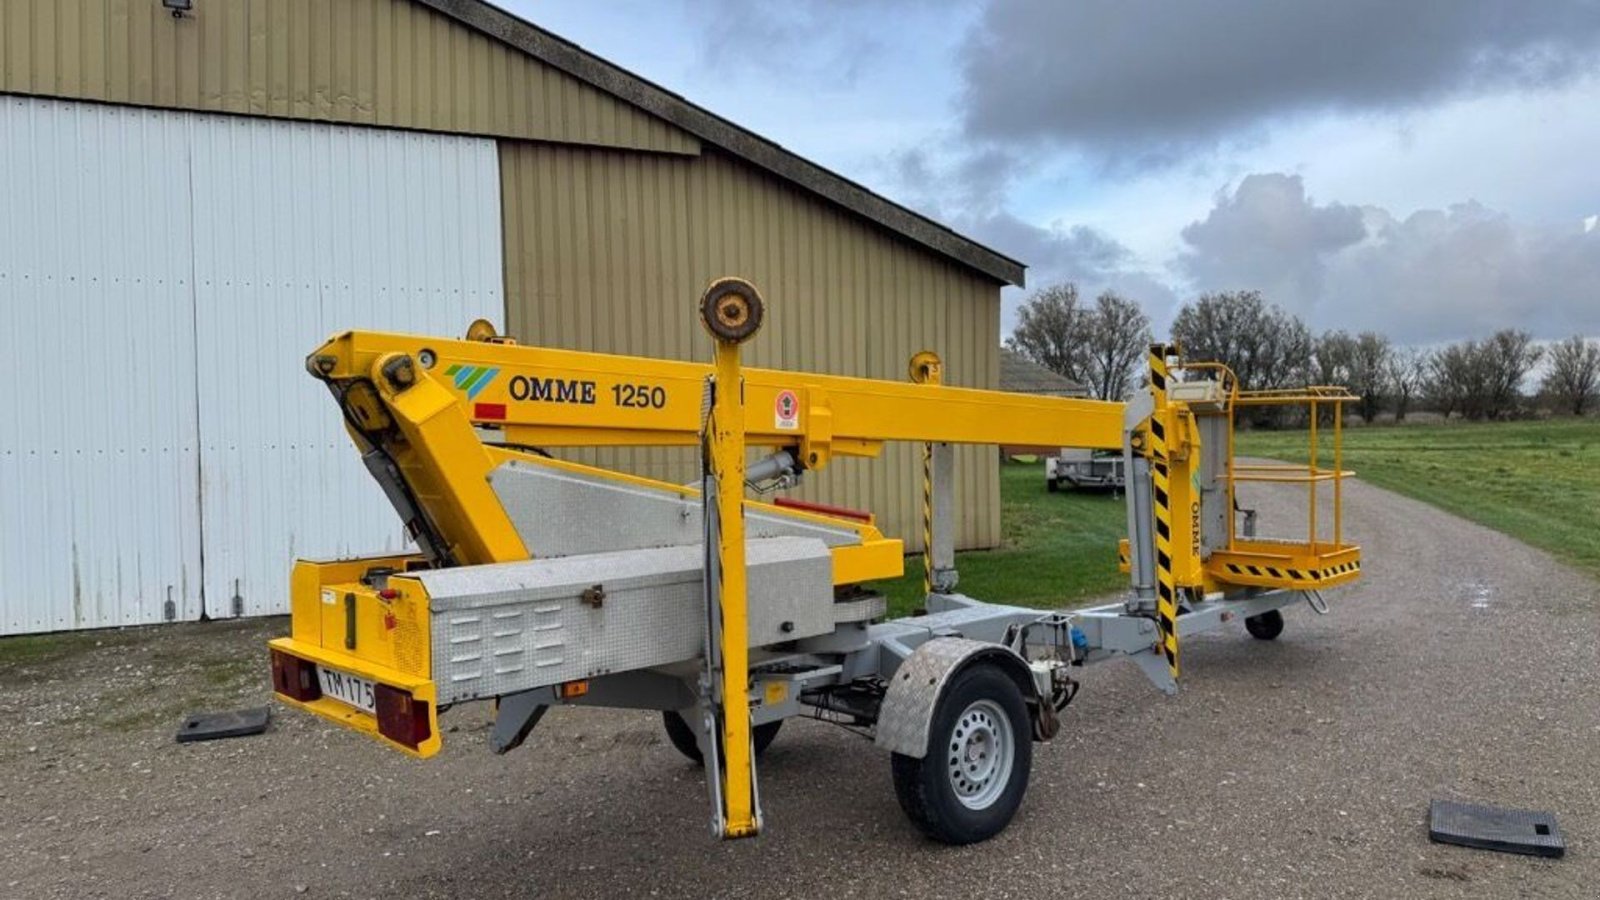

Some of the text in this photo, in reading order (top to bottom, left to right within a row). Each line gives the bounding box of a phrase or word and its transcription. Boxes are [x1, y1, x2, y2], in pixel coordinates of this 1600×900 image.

[509, 375, 666, 409] OMME 1250
[1191, 501, 1200, 557] OMME
[323, 669, 345, 698] TM
